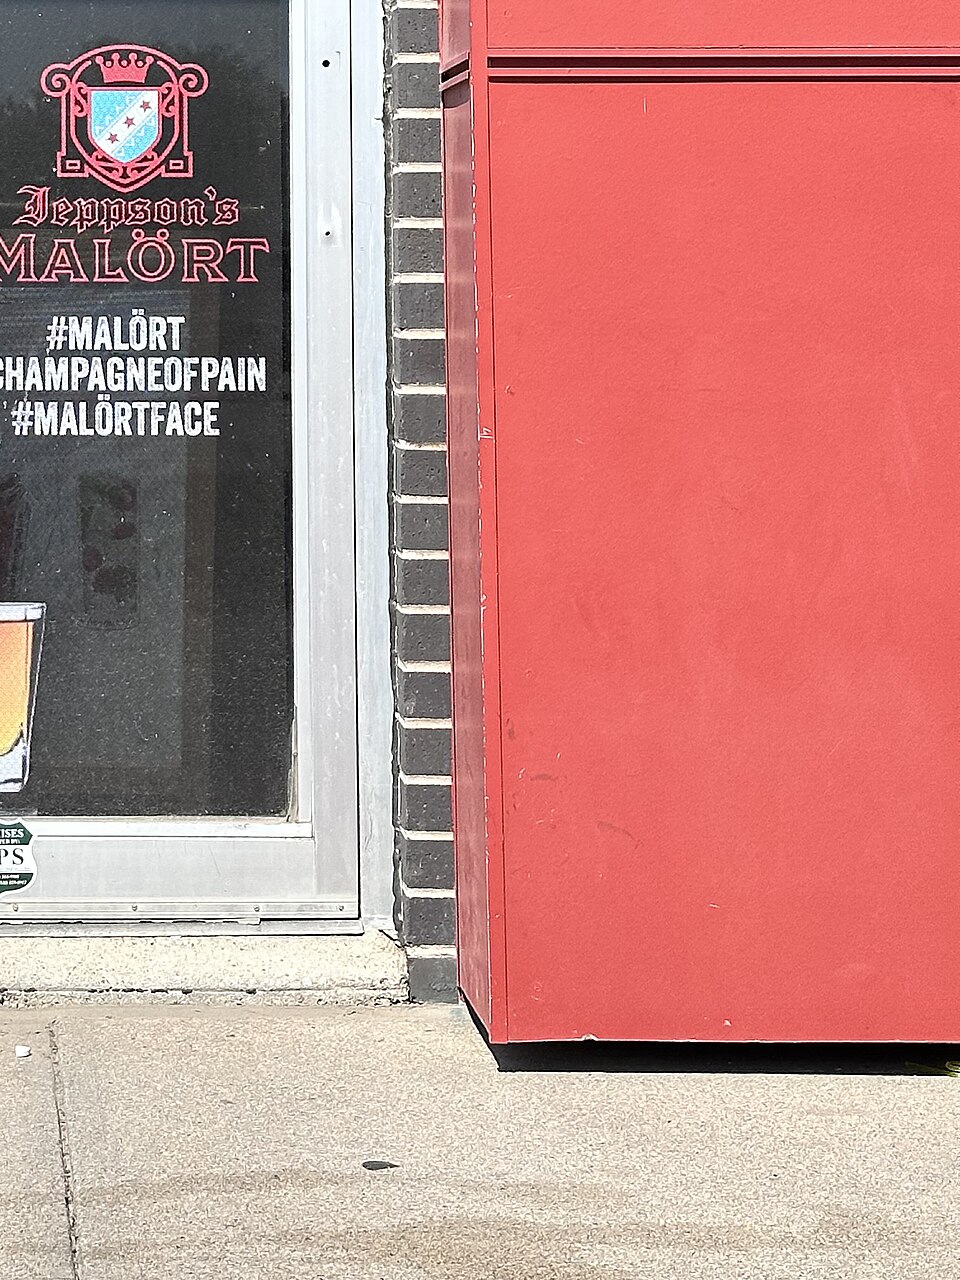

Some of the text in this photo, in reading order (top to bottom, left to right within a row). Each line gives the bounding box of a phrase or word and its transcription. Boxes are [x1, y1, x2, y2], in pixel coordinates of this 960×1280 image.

[12, 185, 240, 234] Jeppson's
[46, 308, 186, 352] #MALÖRT
[11, 394, 221, 437] #MALÖRTFACE
